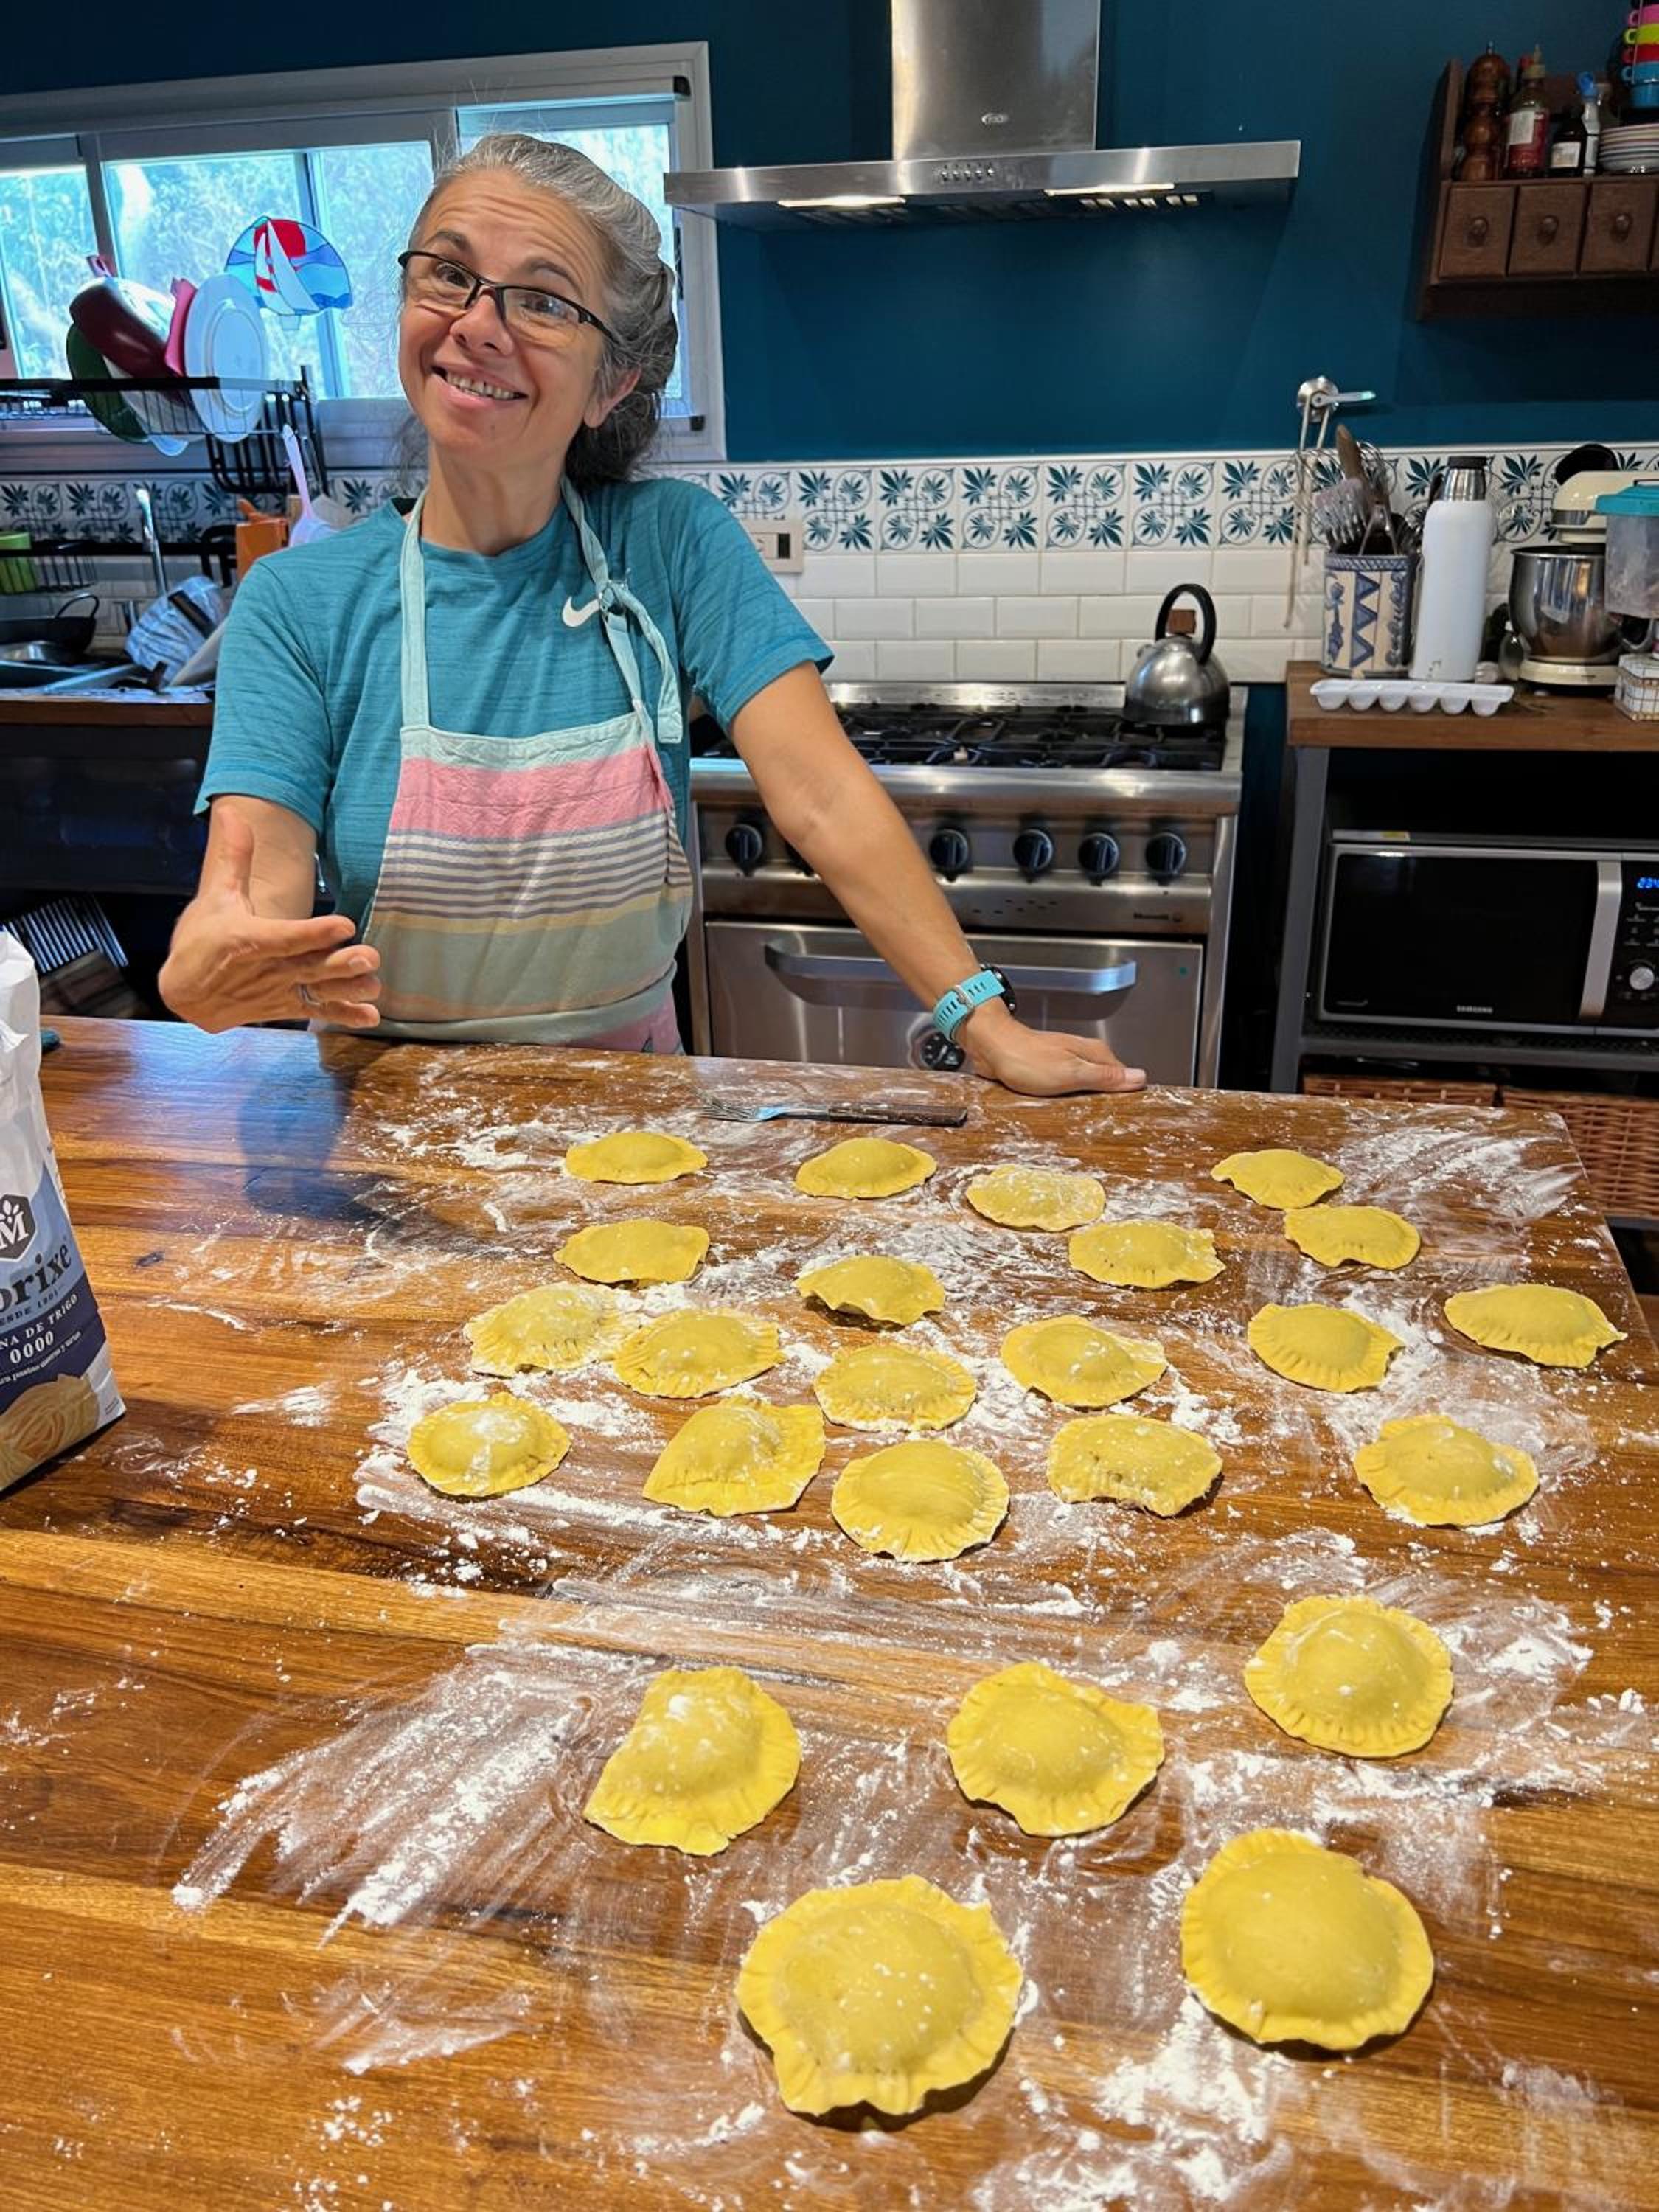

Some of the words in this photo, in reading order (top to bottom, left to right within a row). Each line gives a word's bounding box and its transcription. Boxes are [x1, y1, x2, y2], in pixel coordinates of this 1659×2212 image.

[25, 1322, 44, 1338] DE
[47, 1294, 77, 1325] TRIGO
[10, 1330, 54, 1364] 0000
